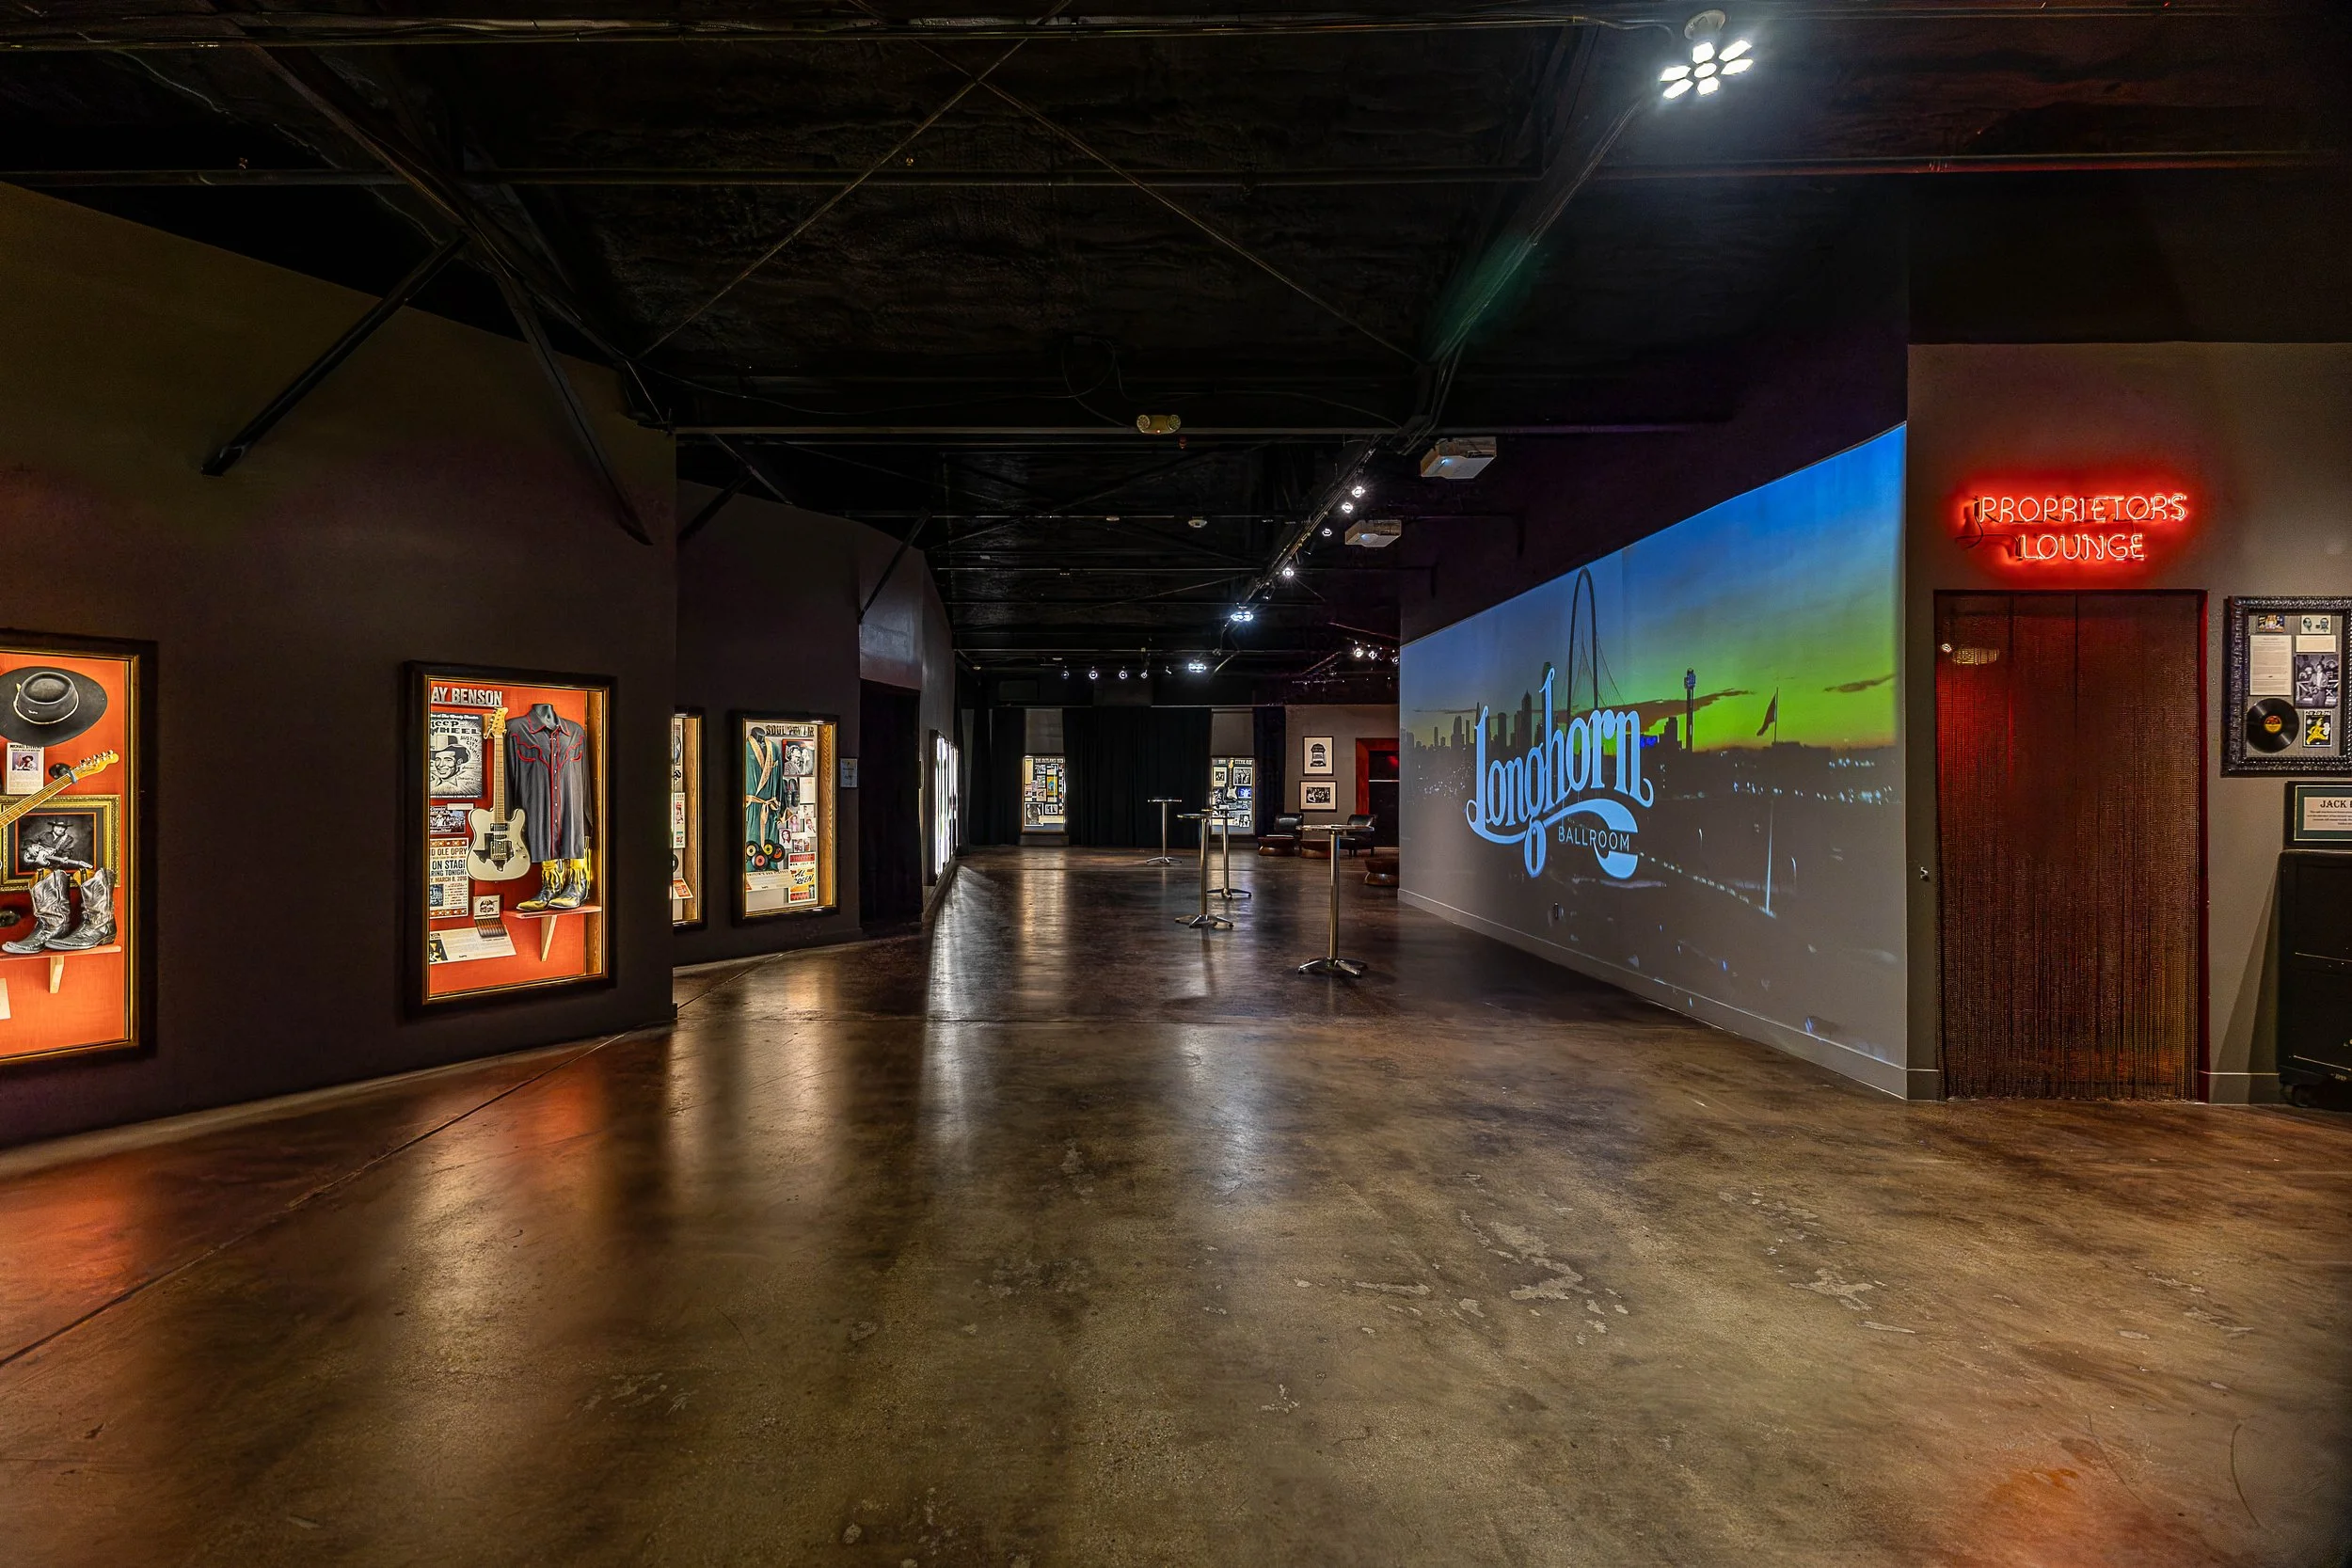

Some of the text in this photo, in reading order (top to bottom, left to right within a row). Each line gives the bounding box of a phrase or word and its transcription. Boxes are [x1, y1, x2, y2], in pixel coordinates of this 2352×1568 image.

[1979, 492, 2188, 523] PROPRIETORS
[2020, 533, 2146, 562] LOUNGE
[431, 686, 502, 707] AY BENSON
[766, 724, 787, 736] SOUL
[1466, 667, 1655, 878] Longhorn
[2320, 800, 2347, 809] JACK
[1558, 826, 1630, 851] BALLROOM
[437, 847, 450, 856] OLE
[451, 847, 468, 856] OPRY
[432, 860, 443, 870] ON
[794, 869, 806, 879] AL
